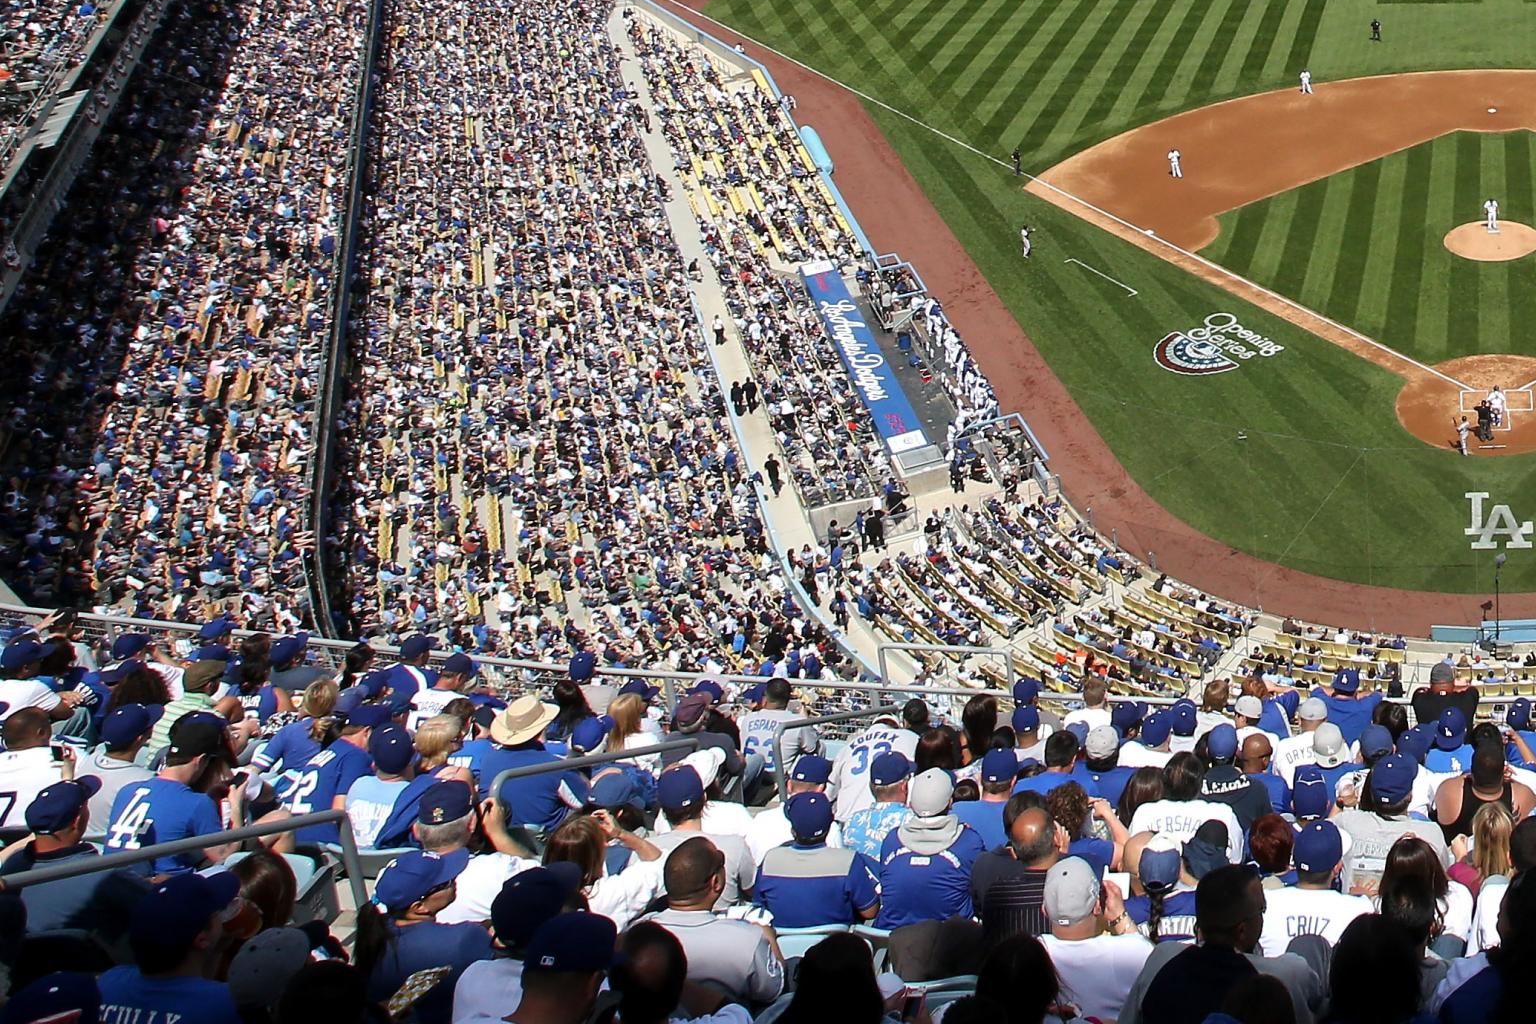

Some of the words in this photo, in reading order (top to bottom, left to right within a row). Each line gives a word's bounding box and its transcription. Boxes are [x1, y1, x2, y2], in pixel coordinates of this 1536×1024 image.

[820, 300, 856, 320] Los
[831, 315, 869, 362] Angeles
[1188, 326, 1256, 360] Series
[1204, 312, 1284, 356] Opening
[850, 354, 888, 401] Dodgers
[1464, 492, 1534, 550] LA
[850, 731, 899, 750] KOUFAX
[108, 788, 154, 850] LA
[1286, 915, 1330, 937] CRUZ
